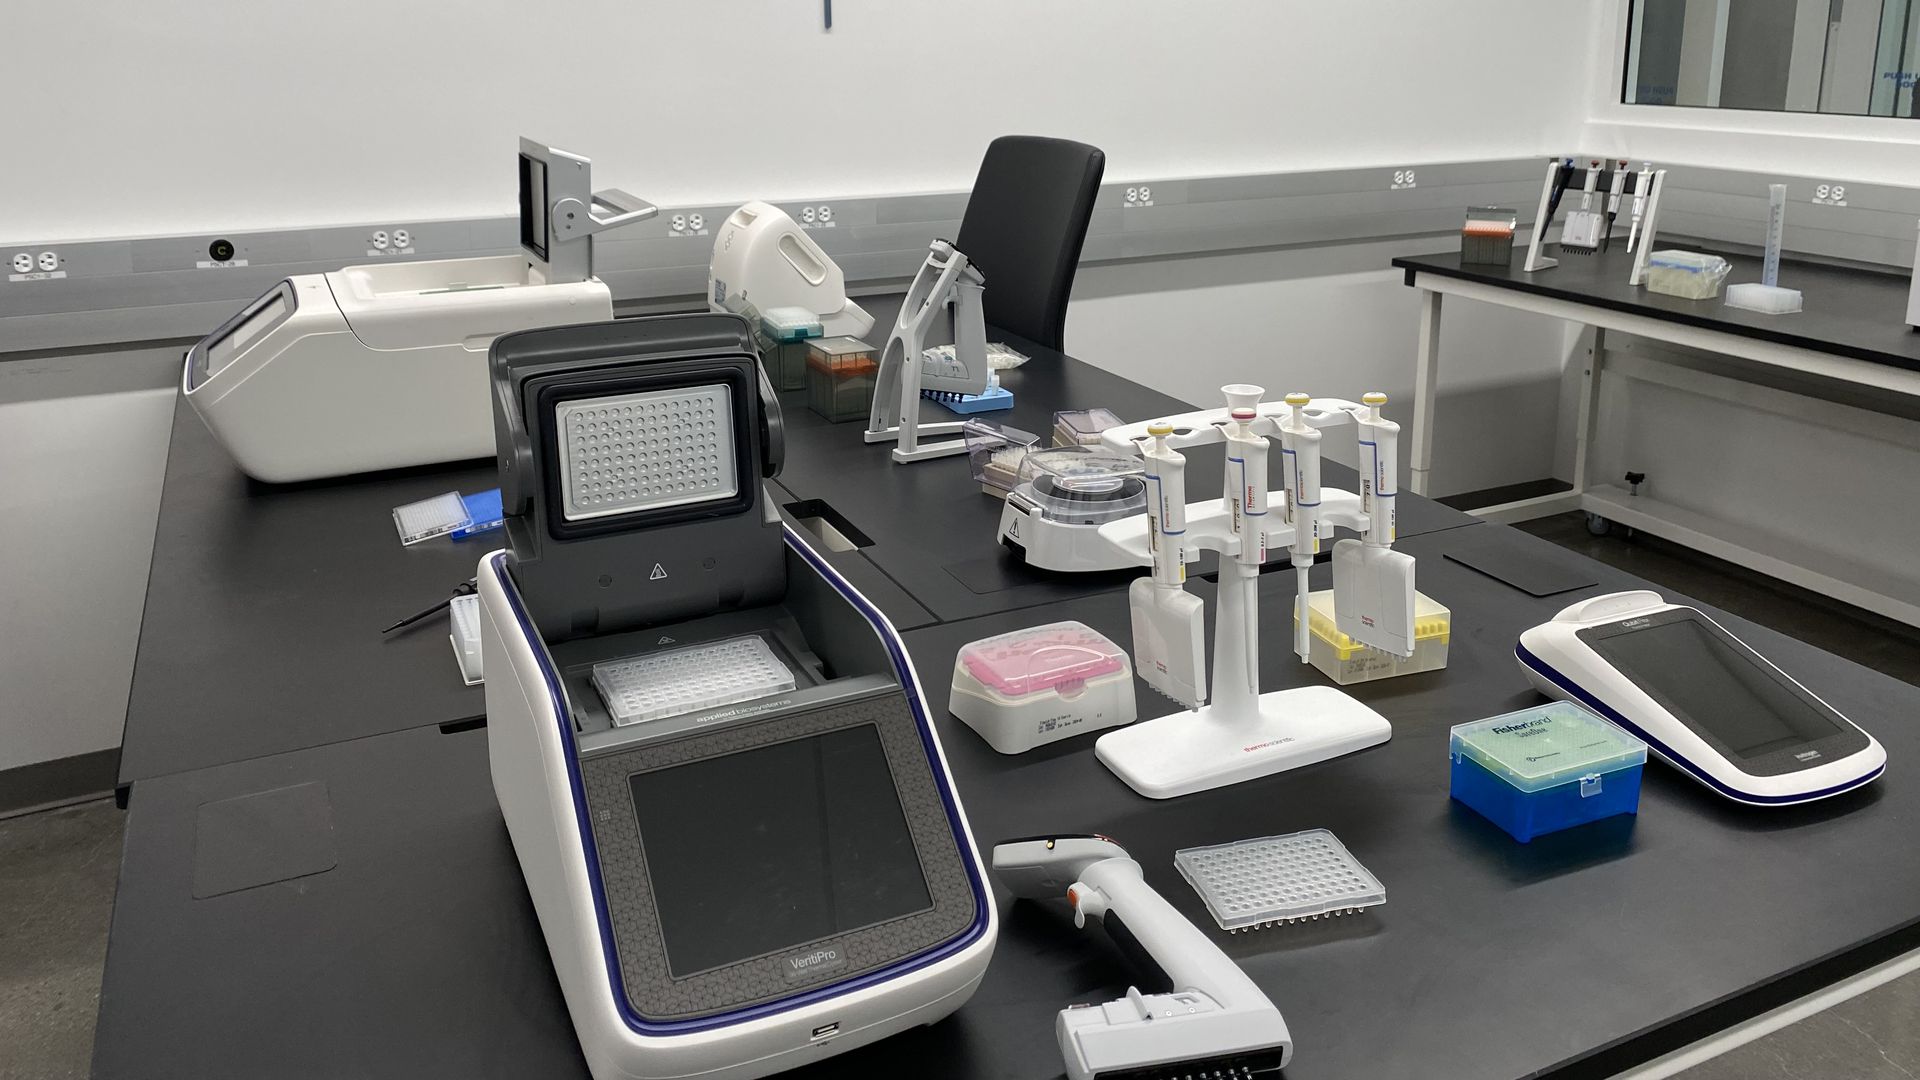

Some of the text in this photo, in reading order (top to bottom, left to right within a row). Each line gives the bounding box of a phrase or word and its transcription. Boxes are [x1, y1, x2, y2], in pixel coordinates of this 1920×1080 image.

[696, 710, 736, 722] applied
[1492, 716, 1553, 735] Fisherbrand
[790, 950, 836, 969] VeritiPro
